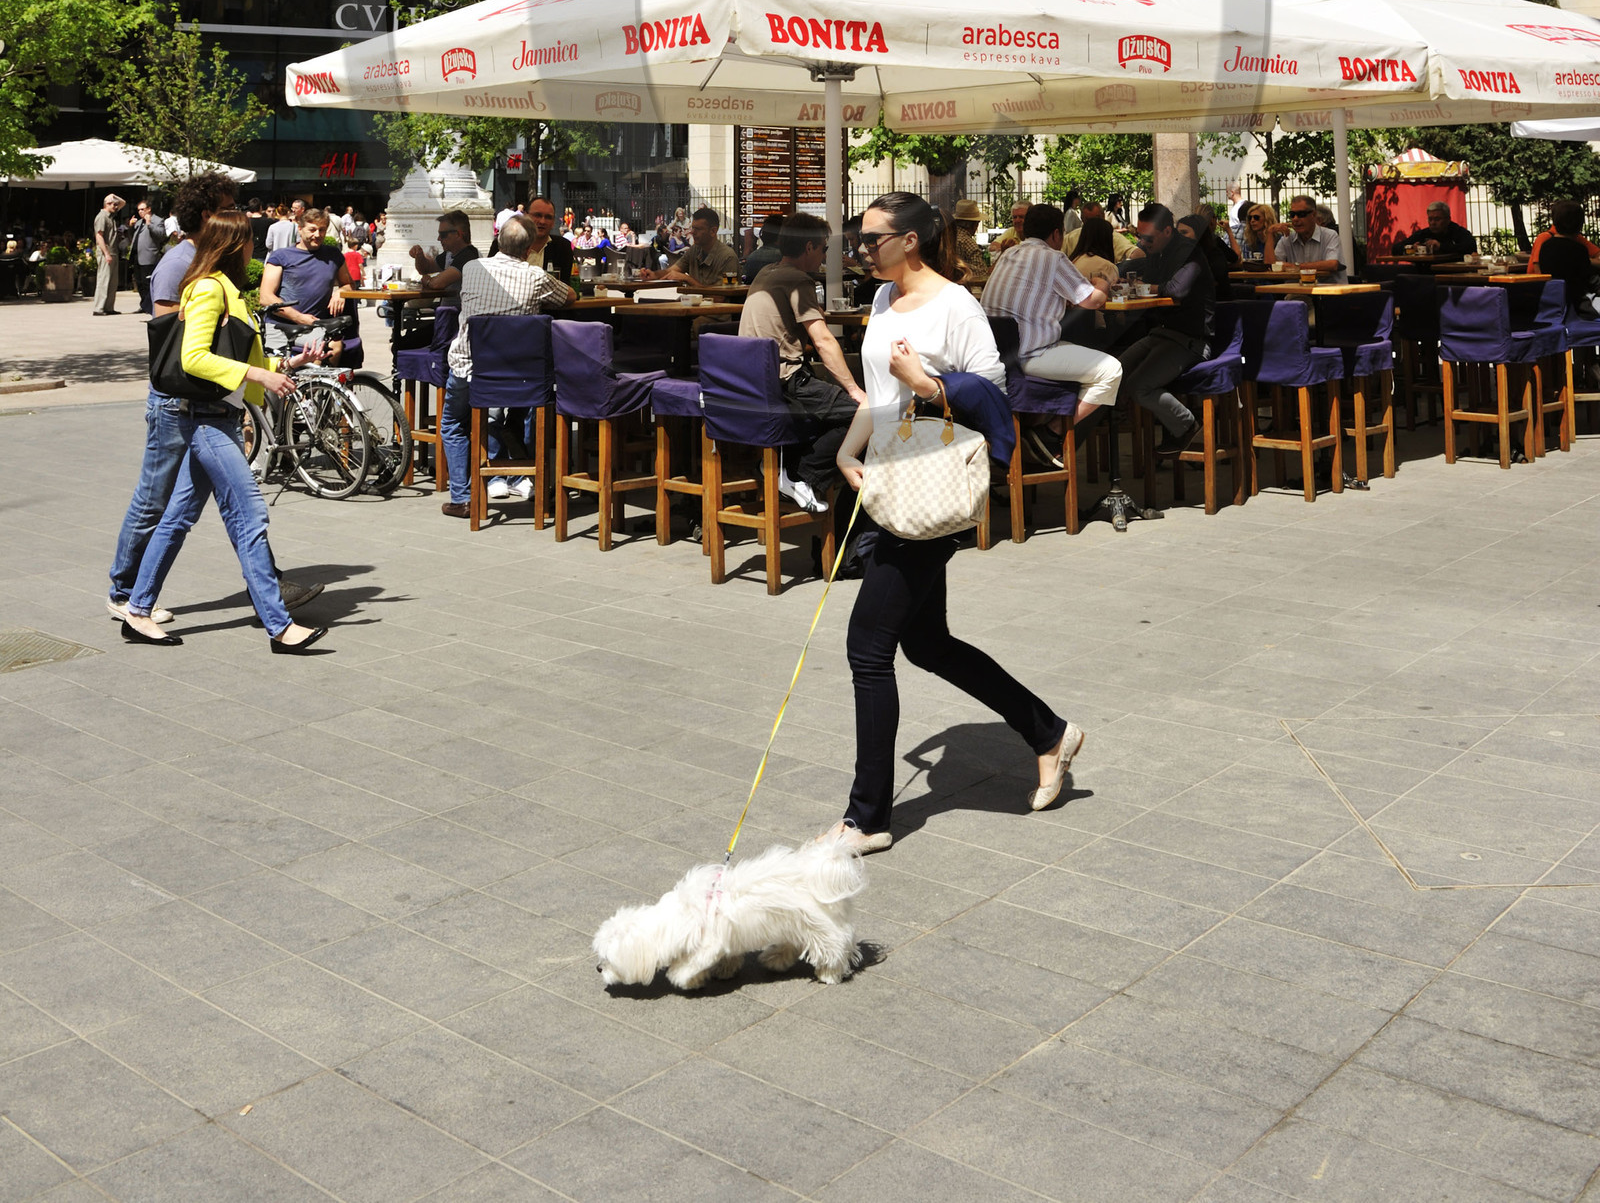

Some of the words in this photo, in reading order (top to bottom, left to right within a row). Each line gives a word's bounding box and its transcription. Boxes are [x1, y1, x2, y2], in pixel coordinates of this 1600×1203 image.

[622, 13, 711, 55] BONITA
[766, 13, 889, 52] BONITA
[962, 23, 1060, 49] arabesca
[512, 40, 580, 71] Jamnica
[963, 51, 1027, 64] espresso
[1031, 52, 1060, 66] kava
[1122, 36, 1168, 62] Ožujsko
[1224, 46, 1299, 75] Jamnica
[363, 59, 410, 79] arabesca
[1338, 56, 1417, 83] BONITA
[1458, 69, 1521, 94] BONITA
[294, 71, 340, 96] BONITA
